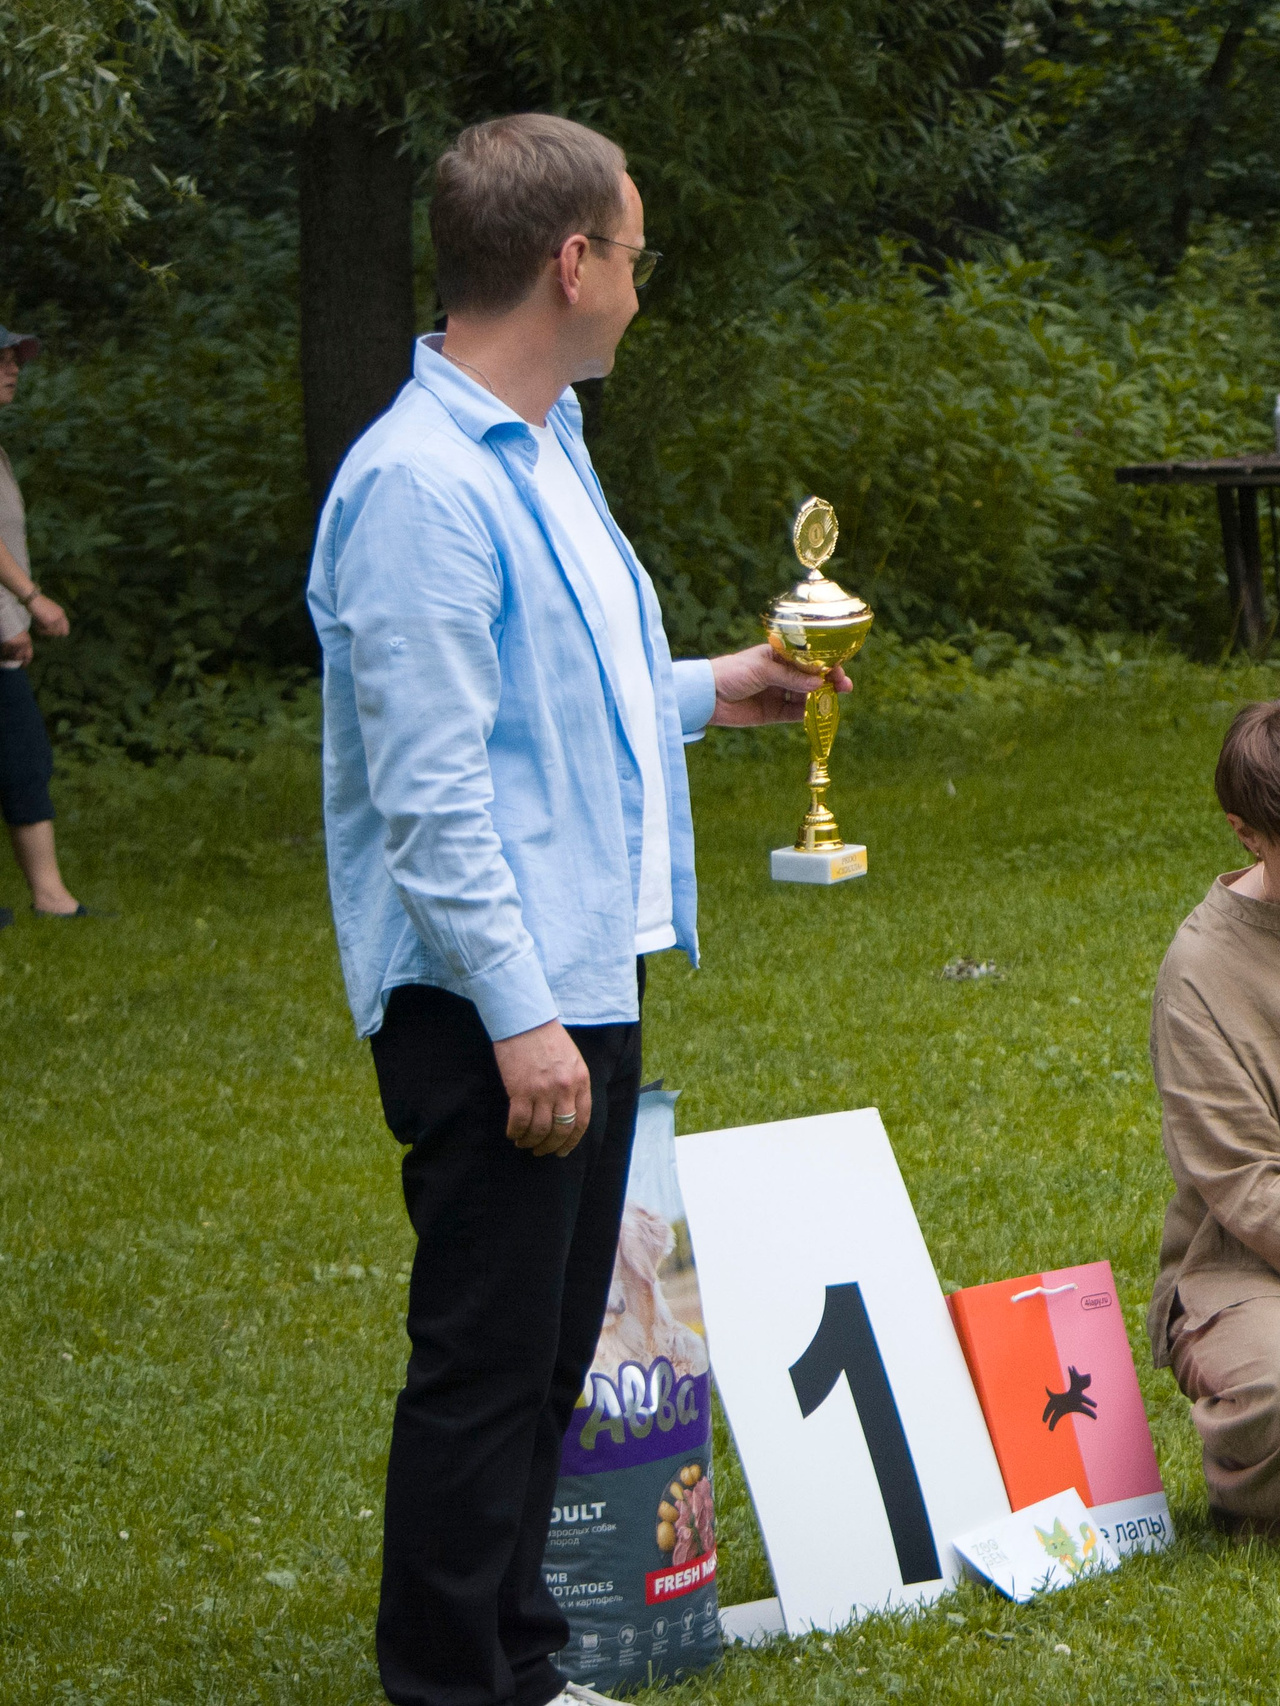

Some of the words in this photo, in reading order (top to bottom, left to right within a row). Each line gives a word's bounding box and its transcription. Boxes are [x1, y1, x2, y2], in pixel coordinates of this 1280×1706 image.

[788, 1281, 943, 1586] 1
[550, 1502, 606, 1523] DULT
[548, 1527, 590, 1538] зрослых
[591, 1522, 617, 1533] собак
[1116, 1514, 1166, 1543] лапы
[550, 1537, 580, 1548] пород
[546, 1572, 568, 1584] MB
[655, 1564, 700, 1595] FRESH
[548, 1581, 614, 1597] OTATOES
[576, 1594, 623, 1608] картофель
